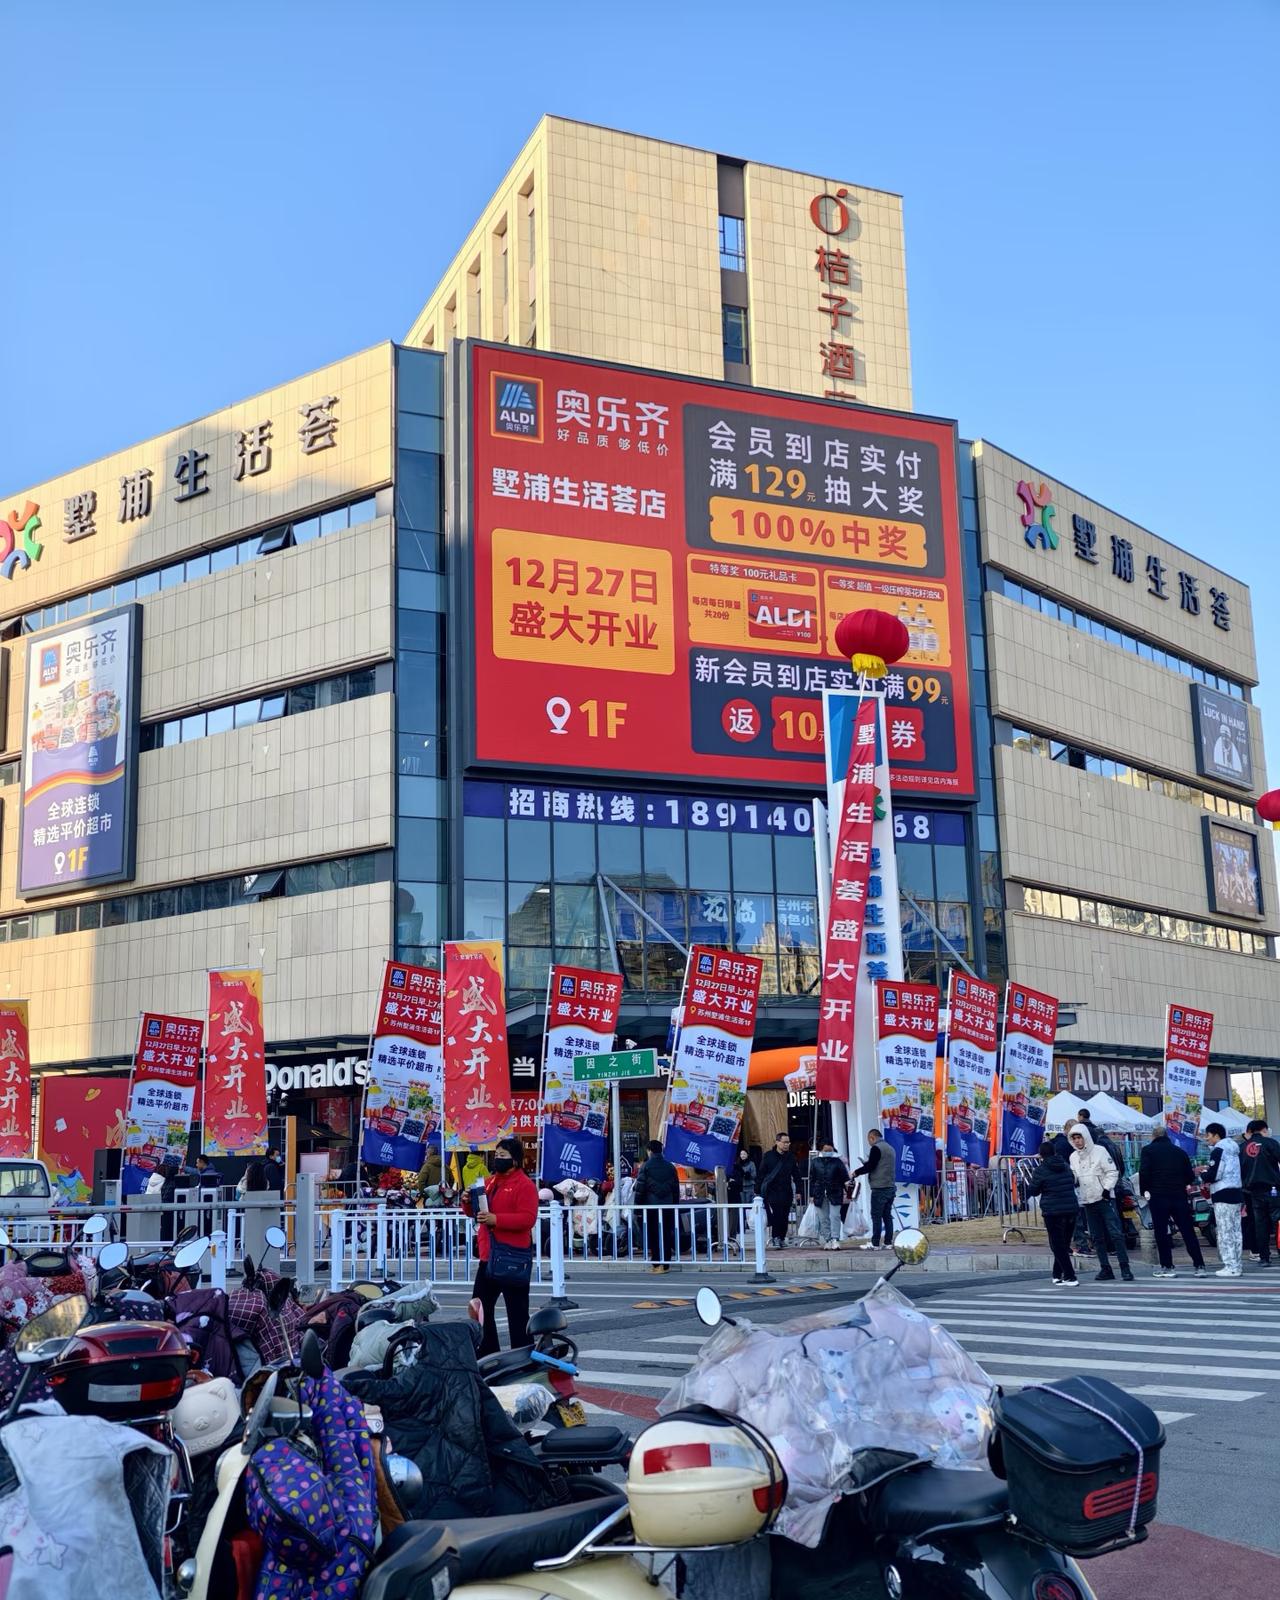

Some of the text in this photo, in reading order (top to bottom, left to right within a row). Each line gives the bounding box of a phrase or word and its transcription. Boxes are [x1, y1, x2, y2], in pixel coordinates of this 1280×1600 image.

[815, 245, 856, 400] 桔子酒
[500, 410, 534, 425] ALDI
[556, 389, 669, 439] 奥乐齐
[506, 422, 529, 433] 奥乐齐
[557, 428, 668, 456] 好品质够低价
[708, 420, 921, 479] 会员到店实付
[63, 394, 341, 544] 墅浦生活荟
[492, 467, 666, 519] 墅浦生活荟店
[731, 509, 908, 561] 100%中奖
[505, 557, 657, 605] 12月27日
[710, 563, 797, 582] 特等奖 100元礼品卡
[1072, 513, 1231, 632] 墅浦生活荟
[831, 579, 855, 590] 一等奖
[693, 596, 741, 610] 每店每日限量
[509, 600, 658, 650] 盛大开业
[705, 609, 729, 620] 共20份
[756, 605, 811, 628] ALDI
[66, 629, 117, 665] 奥乐齐
[695, 655, 949, 705] 新会员到店实付满99元
[578, 699, 627, 739] 1F
[728, 708, 755, 736] 返
[1203, 706, 1221, 721] LUCK
[1228, 715, 1246, 731] HAND
[891, 720, 916, 749] 券
[47, 792, 100, 821] 全球连锁
[509, 787, 930, 840] 招商热线:18914068
[33, 813, 112, 847] 精选平价超市
[67, 846, 89, 873] 1F
[819, 723, 876, 1063] 墅浦生活荟盛大开业
[718, 958, 758, 979] 奥乐齐
[580, 980, 618, 997] 奥乐齐
[695, 979, 755, 998] 12月27日早上7点
[970, 984, 996, 1003] 奥乐齐
[692, 989, 753, 1015] 盛大开业
[901, 992, 936, 1007] 奥乐齐
[1027, 997, 1056, 1016] 奥乐齐
[385, 1001, 443, 1026] 盛大开业
[557, 1001, 613, 1023] 盛大开业
[884, 1013, 935, 1031] 盛大开业
[954, 1009, 995, 1032] 盛大开业
[1185, 1013, 1212, 1028] 奥乐齐
[165, 1022, 200, 1037] 奥乐齐
[1012, 1013, 1052, 1037] 盛大开业
[145, 1040, 198, 1054] 12月27日早上7点
[389, 1044, 427, 1060] 全球连锁
[459, 975, 497, 1110] 盛大开业
[565, 1036, 600, 1051] 全球连锁
[697, 1035, 737, 1052] 全球连锁
[894, 1045, 927, 1057] 全球连锁
[1170, 1034, 1208, 1052] 盛大开业
[142, 1049, 196, 1067] 盛大开业
[220, 1000, 254, 1120] 盛大开业
[378, 1054, 434, 1073] 精选平价超市
[512, 1056, 535, 1077] 当
[685, 1045, 745, 1067] 精选平价超市
[885, 1056, 933, 1070] 精选平价超市
[137, 1097, 189, 1111] 精选平价超市
[147, 1088, 182, 1100] 全球连锁
[787, 1090, 821, 1107] DI奥乐
[559, 1161, 582, 1174] ALDI
[901, 1164, 914, 1173] ADI
